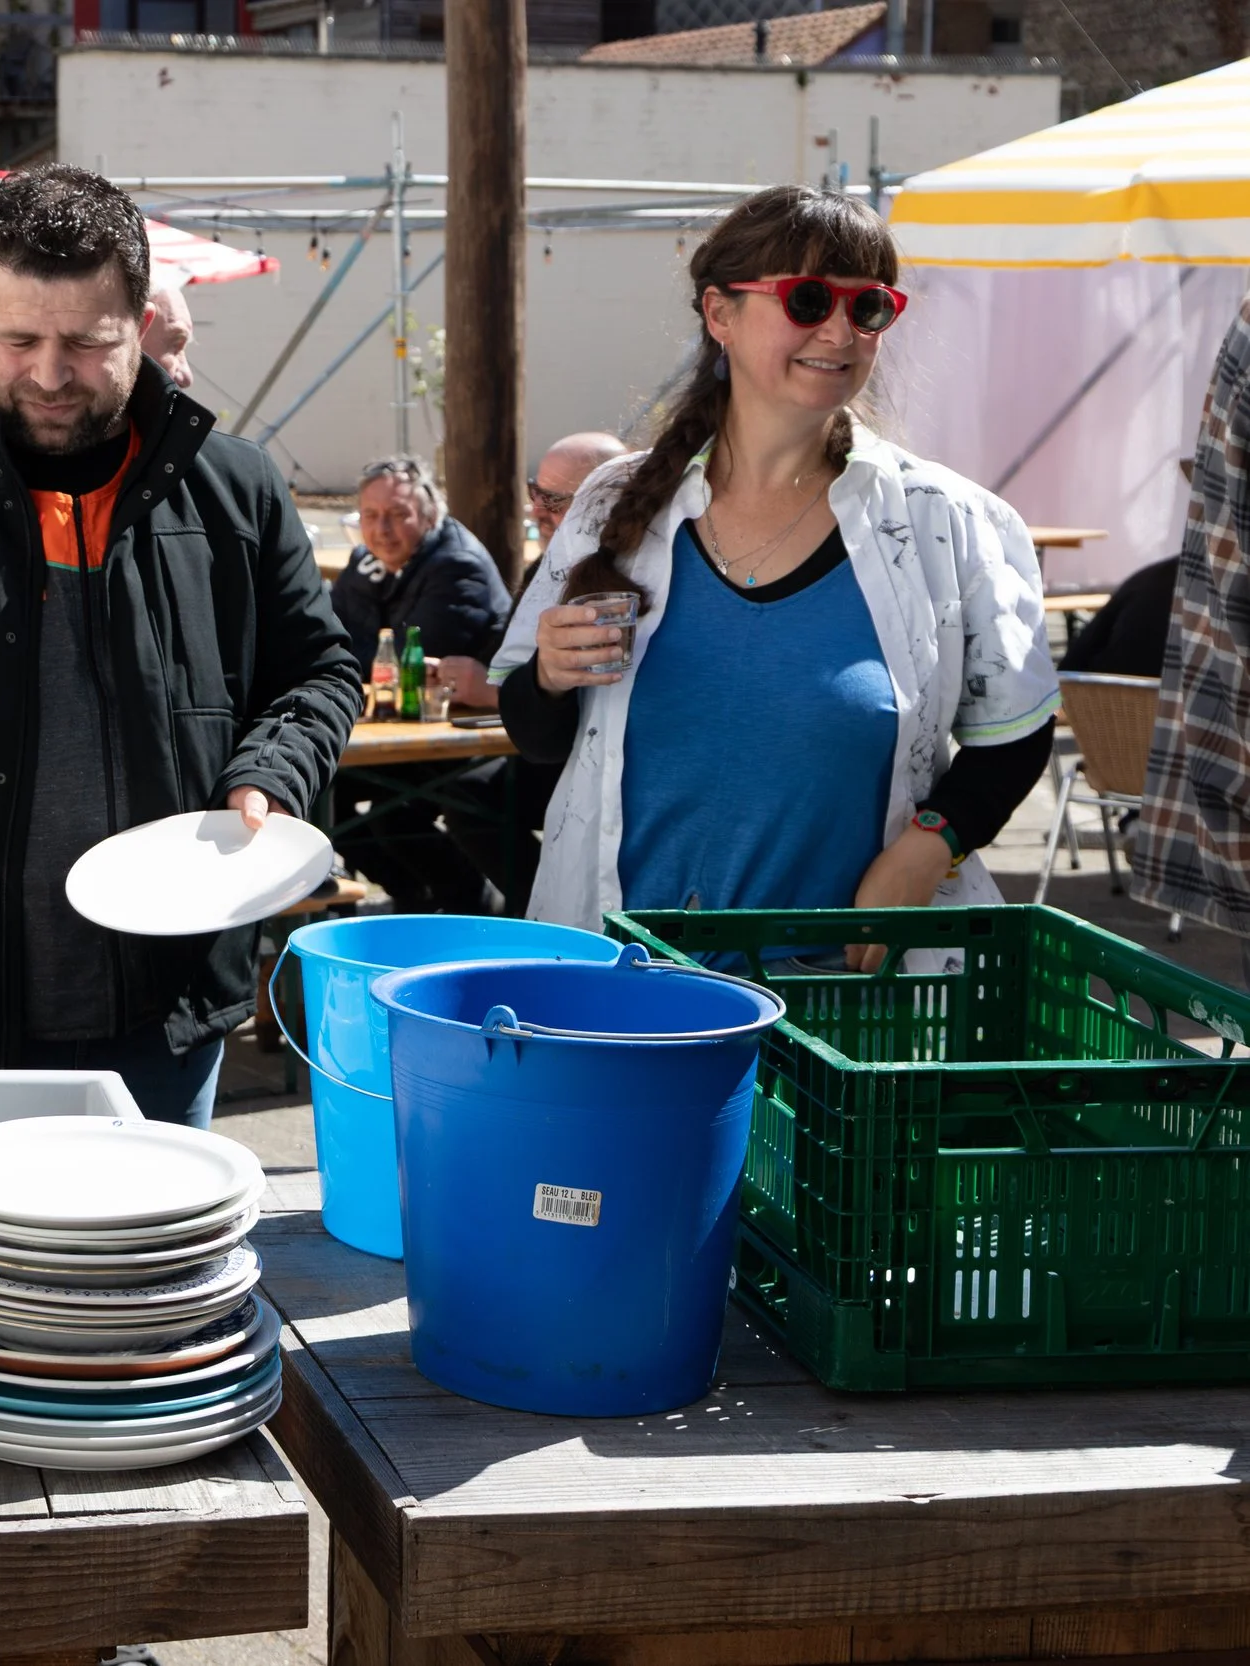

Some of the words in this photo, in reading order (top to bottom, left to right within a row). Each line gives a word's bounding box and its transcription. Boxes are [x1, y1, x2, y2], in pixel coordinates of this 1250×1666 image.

[541, 1186, 559, 1197] SEAU
[561, 1189, 569, 1199] 12
[580, 1191, 598, 1202] BLEU
